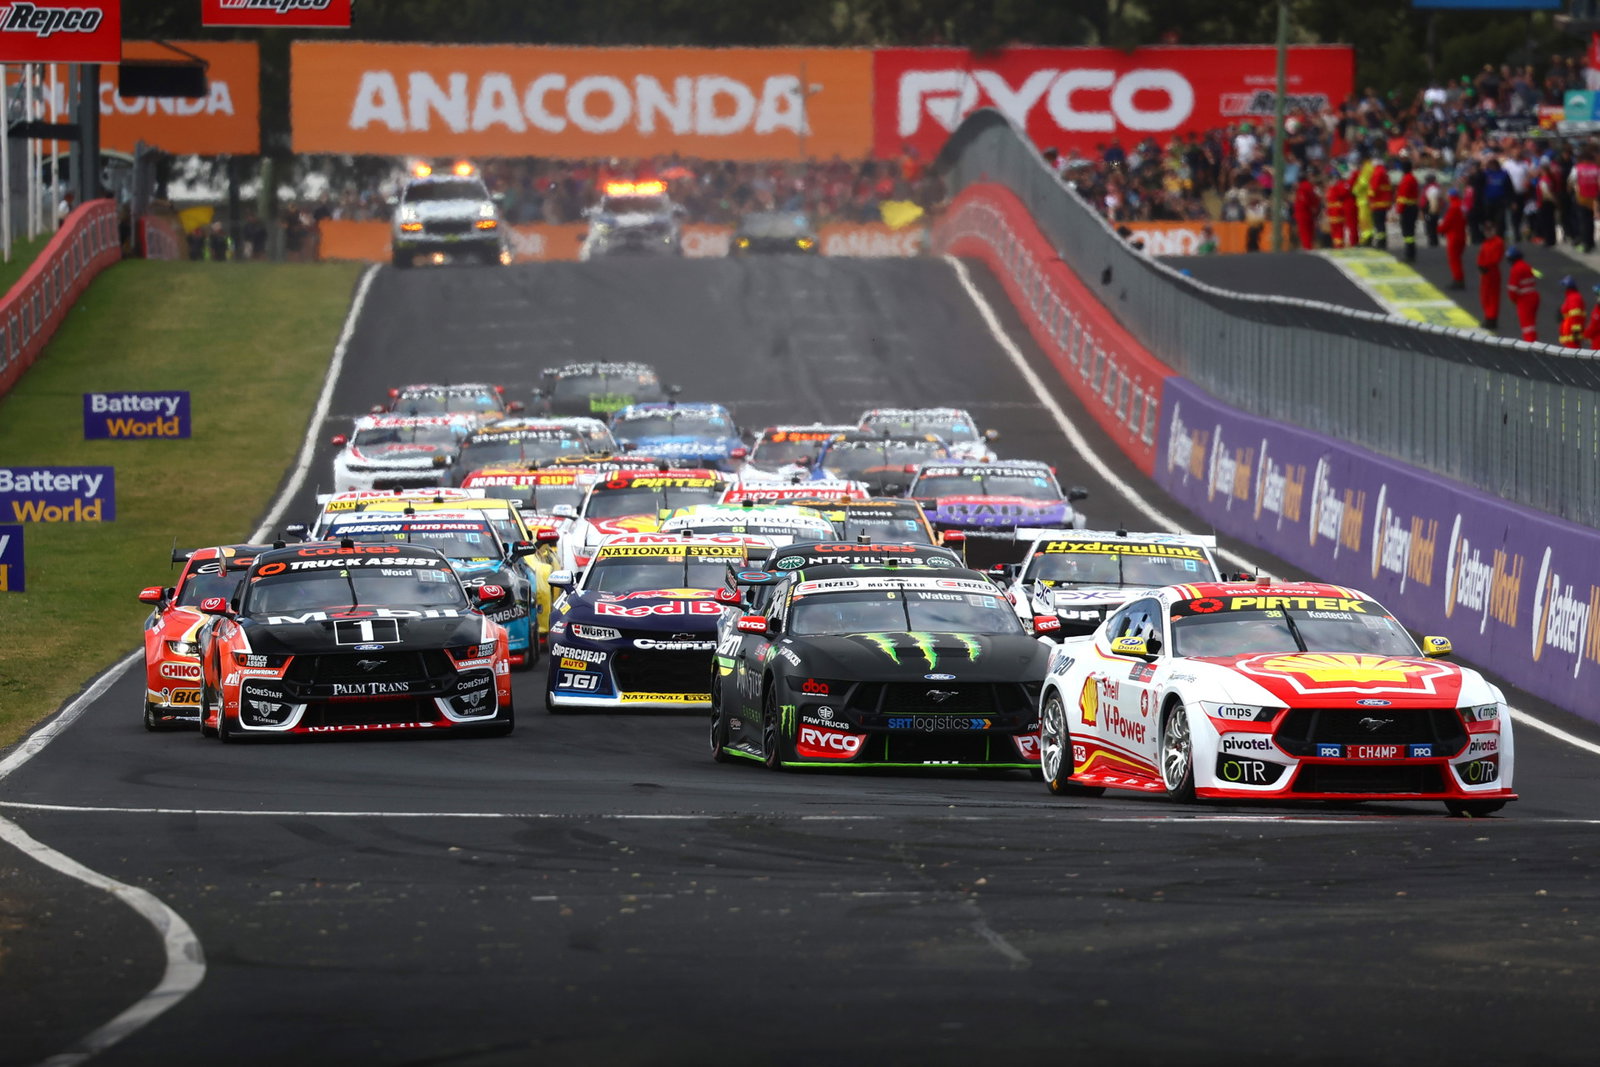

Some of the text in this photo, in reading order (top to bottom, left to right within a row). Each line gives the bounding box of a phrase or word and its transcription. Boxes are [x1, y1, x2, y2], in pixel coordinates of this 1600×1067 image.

[6, 2, 103, 37] Repco
[349, 71, 810, 134] ANACONDA
[897, 68, 1194, 137] RYCO
[91, 394, 180, 416] Battery
[106, 416, 180, 437] World
[0, 470, 103, 498] Battery
[470, 476, 517, 487] MAKE
[519, 476, 536, 486] IT
[12, 498, 102, 522] World
[752, 516, 826, 526] TRUCKS
[336, 524, 403, 534] BURSON
[602, 546, 744, 556] NATIONAL STORA
[1045, 540, 1201, 559] Hydraulink
[290, 557, 439, 571] TRUCK ASSIST
[808, 555, 923, 565] NTK FILRS
[1110, 554, 1118, 562] 4
[381, 568, 413, 577] Wood
[817, 581, 855, 589] ENZED
[957, 581, 992, 591] ENZED
[1457, 538, 1494, 635] Battery
[1490, 549, 1524, 628] World
[886, 591, 896, 600] 6
[917, 592, 963, 602] Waters
[595, 601, 685, 617] Red
[1230, 596, 1367, 613] PIRTEK
[268, 608, 459, 625] Mobil
[1265, 610, 1283, 619] 38
[1307, 610, 1353, 621] Kostecki
[353, 620, 375, 642] 1
[737, 621, 766, 629] RYCO
[1546, 573, 1590, 679] Battery
[552, 642, 607, 665] SUPERCHEAP
[161, 663, 201, 677] CHIKO
[563, 659, 584, 668] AUTO
[333, 681, 410, 695] PALM TRANS
[559, 673, 598, 690] JGI
[802, 678, 829, 693] dba
[1103, 676, 1119, 701] Shell
[1226, 707, 1252, 719] mps
[1483, 707, 1498, 719] mps
[802, 716, 850, 730] FAW TRUCKS
[1103, 702, 1146, 745] V-Power
[801, 729, 859, 751] RYCO
[1321, 747, 1340, 757] PPQ
[1358, 746, 1397, 758] CH4MP
[1224, 761, 1266, 782] OTR
